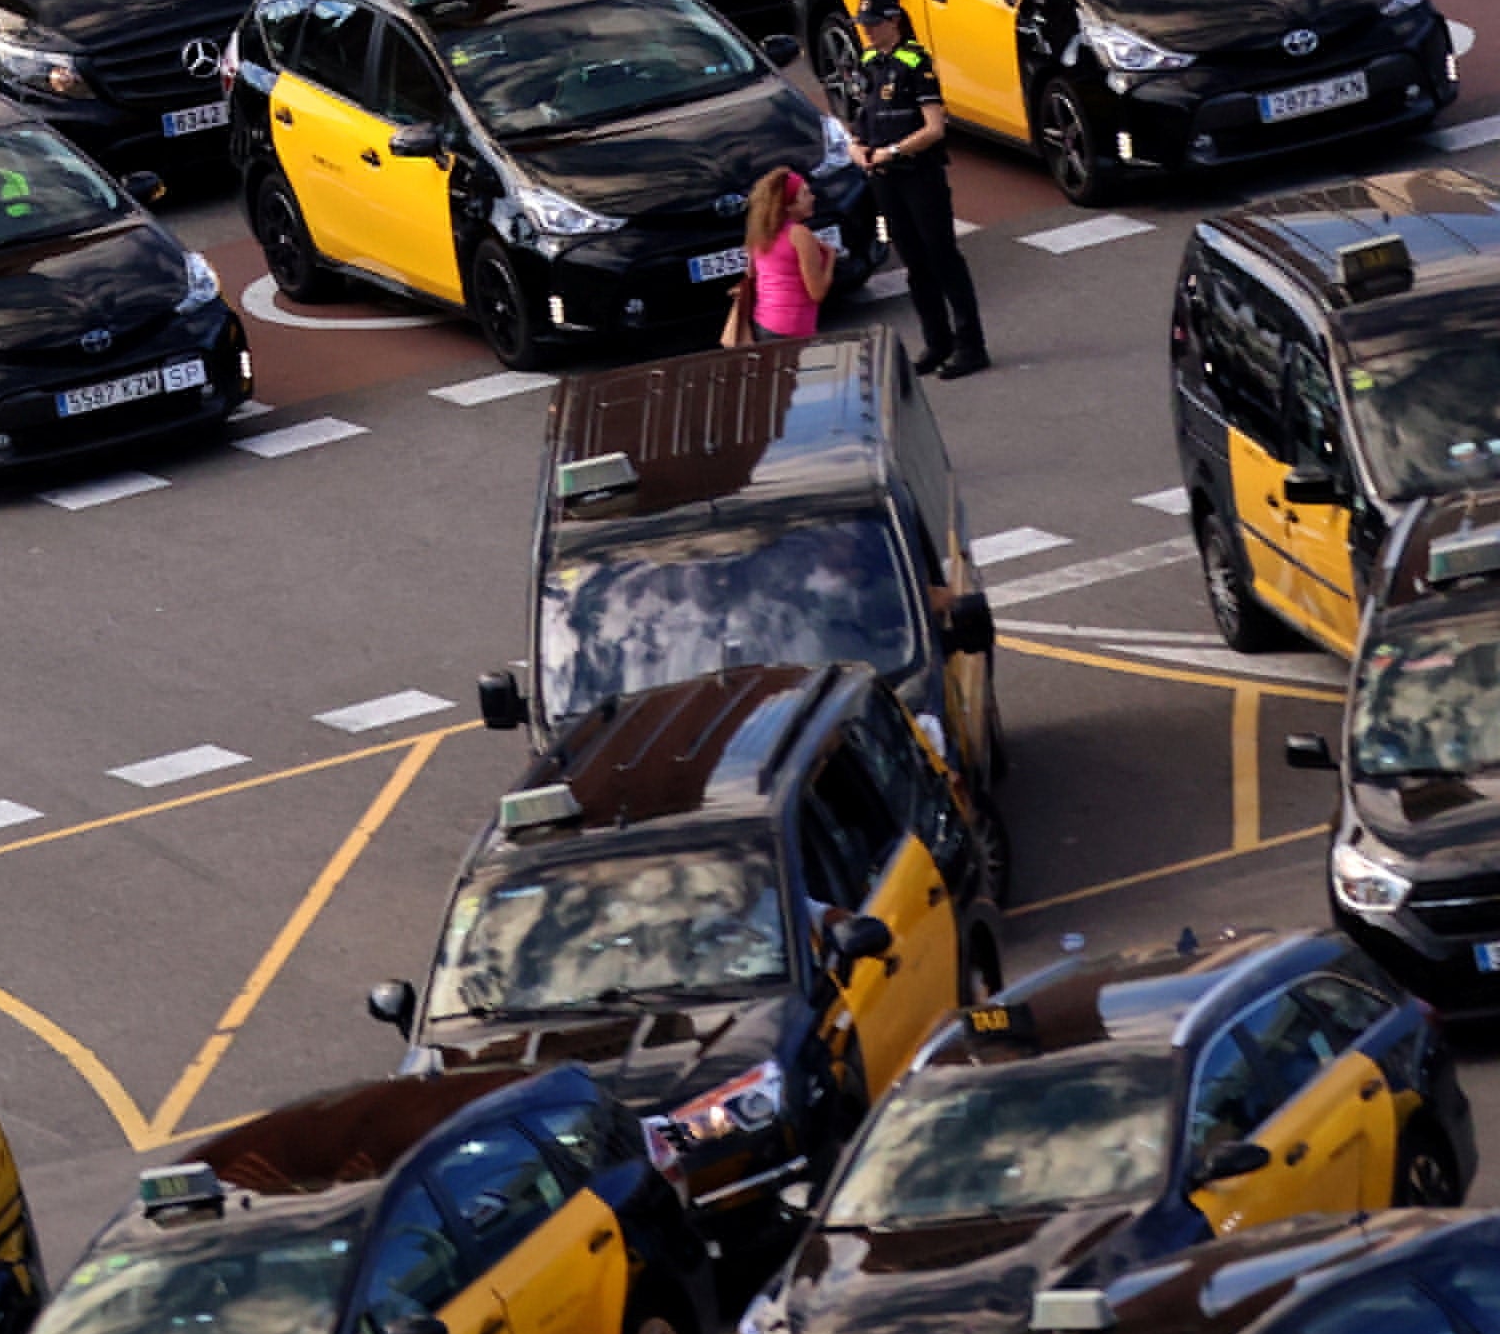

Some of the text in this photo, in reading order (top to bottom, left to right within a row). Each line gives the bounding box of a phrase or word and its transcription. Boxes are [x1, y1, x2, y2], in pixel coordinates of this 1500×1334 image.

[1329, 77, 1365, 103] JKN
[165, 363, 202, 389] SP
[971, 1009, 1009, 1031] TAXI
